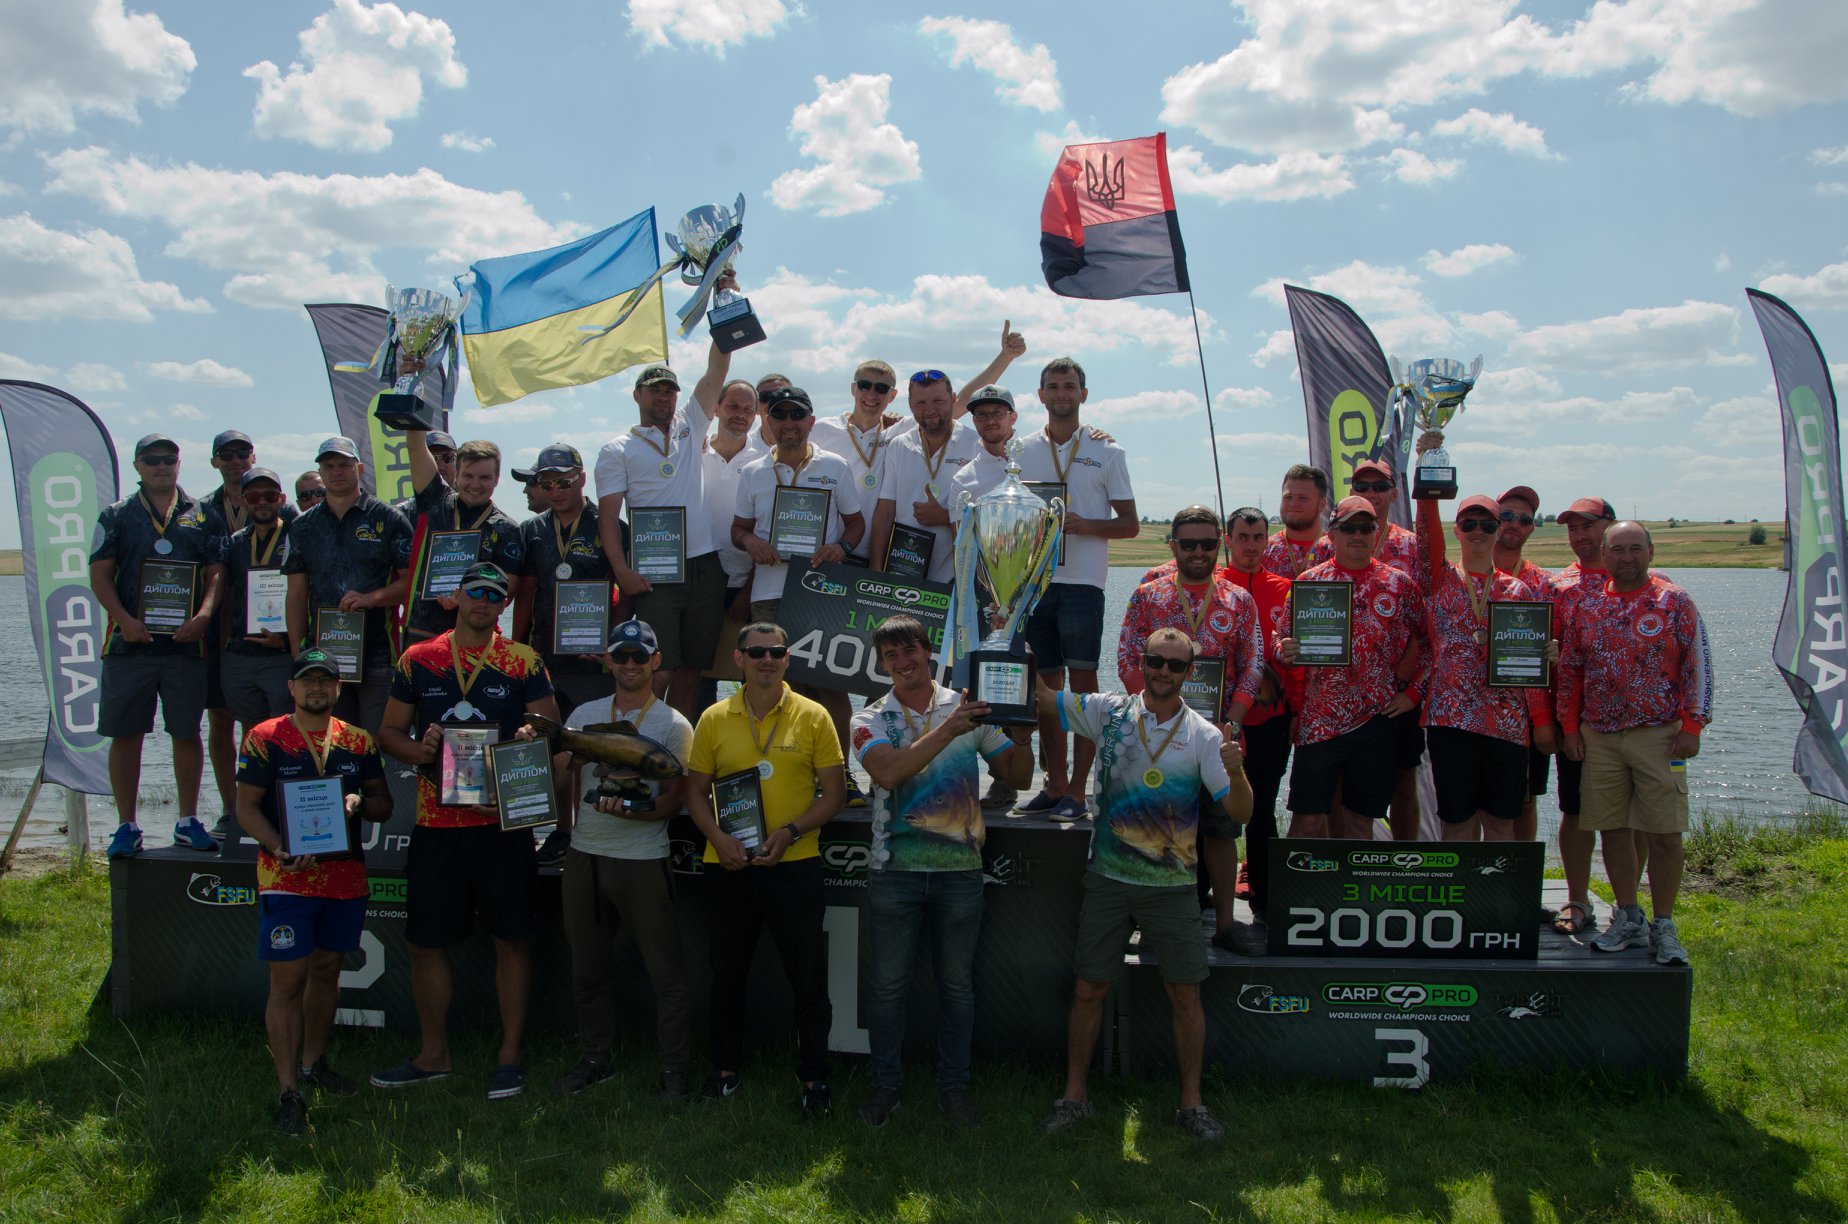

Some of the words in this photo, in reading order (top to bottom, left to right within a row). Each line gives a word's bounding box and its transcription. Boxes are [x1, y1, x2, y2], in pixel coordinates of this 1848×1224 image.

[778, 511, 822, 523] ДИПЛОМ
[635, 532, 680, 543] ДИПЛОМ
[432, 553, 475, 563] ДИПЛОМ
[891, 549, 925, 565] ДИПЛОМ
[143, 584, 191, 596] ДИПЛОМ
[820, 581, 848, 597] FSFU
[858, 582, 892, 596] CARP
[922, 593, 949, 607] PRO
[559, 605, 605, 615] ДИПЛОМ
[856, 598, 891, 610] WORLDWIDE
[890, 604, 924, 616] CHAMPIONS
[924, 610, 945, 620] CHOICE
[1297, 610, 1346, 620] ДИПЛОМ
[321, 632, 361, 641] ДИПЛОМ
[1495, 630, 1546, 641] ДИПЛОМ
[1181, 685, 1218, 694] ИПЛОМ
[1104, 714, 1124, 768] UKRAIN
[500, 766, 548, 784] ДИПЛОМ
[719, 799, 757, 819] ДИПЛОМ
[384, 834, 411, 851] ГР
[1309, 859, 1340, 871] FSFU
[1352, 853, 1389, 864] CARP
[1427, 855, 1455, 865] PRO
[216, 886, 256, 905] FSFU
[1342, 883, 1360, 902] 3
[1369, 884, 1466, 906] МІСЦЕ
[1287, 907, 1463, 949] 2000
[1469, 932, 1521, 949] ГРН
[823, 905, 872, 1055] 1
[1328, 987, 1379, 1001] CARP
[1432, 988, 1471, 1002] PRO
[1268, 993, 1310, 1013] FSFU
[1328, 1011, 1383, 1021] WORLDWIDE
[1383, 1012, 1438, 1022] CHAMPIONS
[1439, 1013, 1471, 1022] CHOICE
[1373, 1027, 1430, 1089] 3
